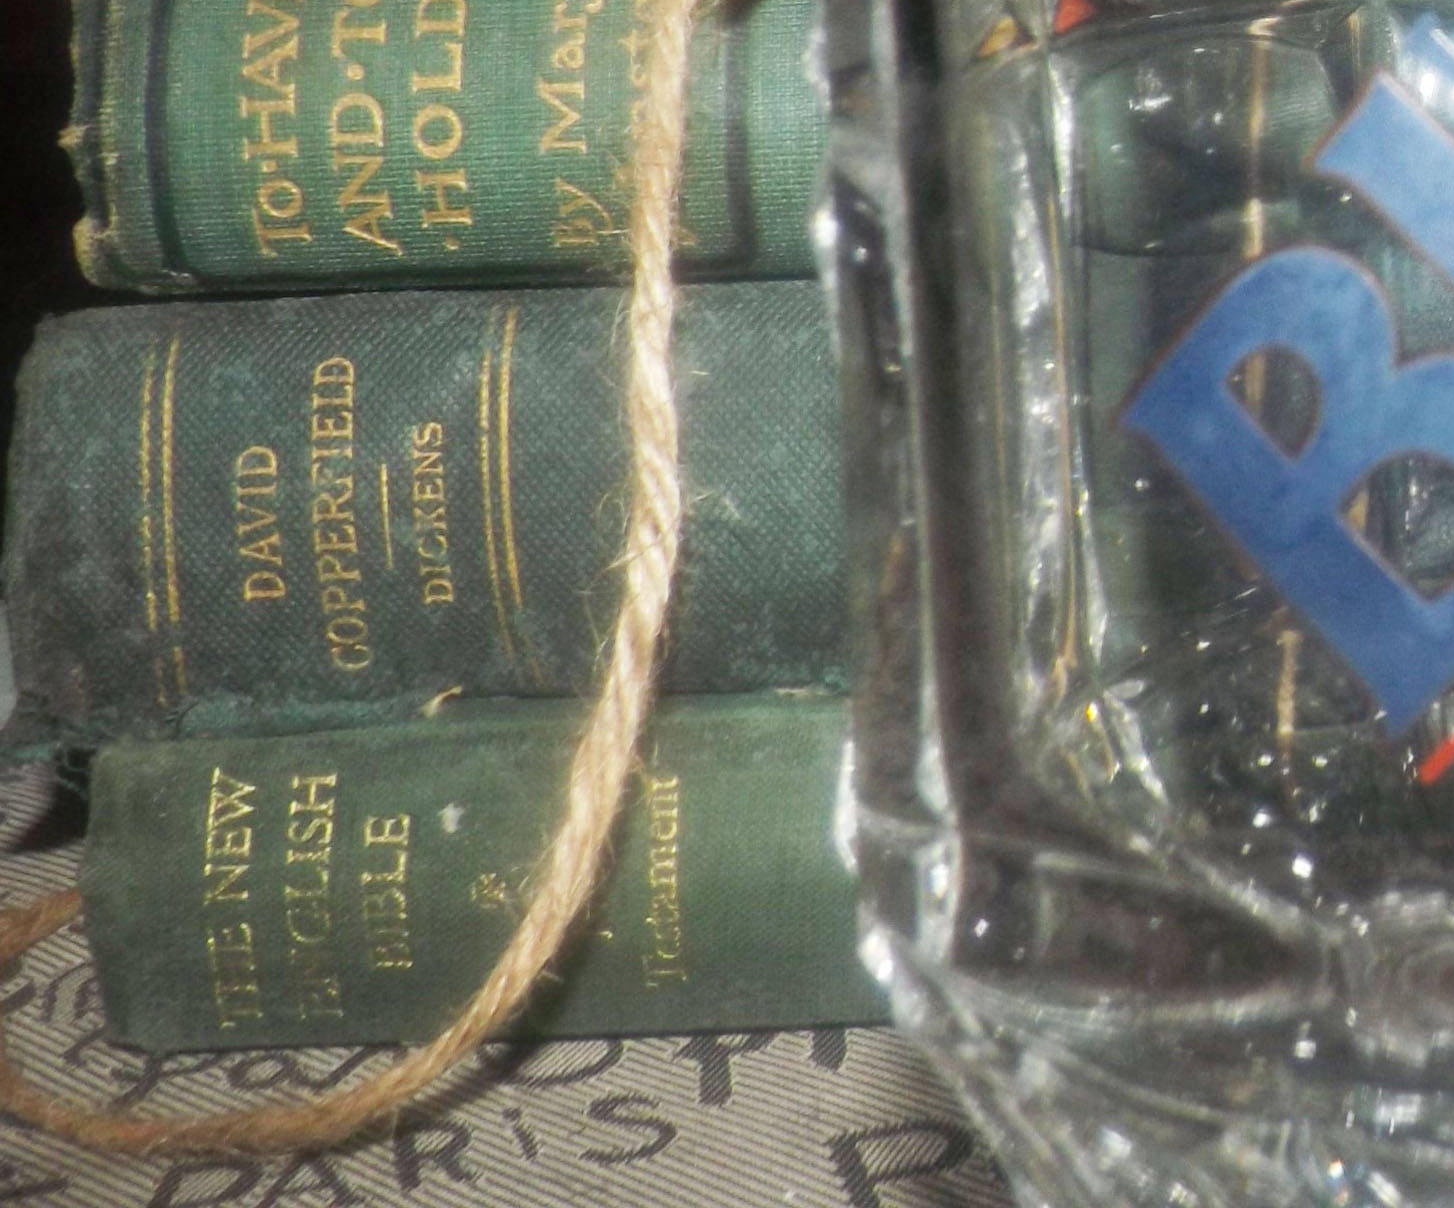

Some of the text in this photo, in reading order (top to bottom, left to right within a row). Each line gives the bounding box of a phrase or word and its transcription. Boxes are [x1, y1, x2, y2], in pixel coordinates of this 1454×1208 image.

[236, 445, 287, 603] DAVID
[310, 356, 374, 672] COPPERFIELD
[411, 420, 455, 606] DICKENS
[203, 765, 257, 908] NEW
[359, 812, 414, 969] BIBLE
